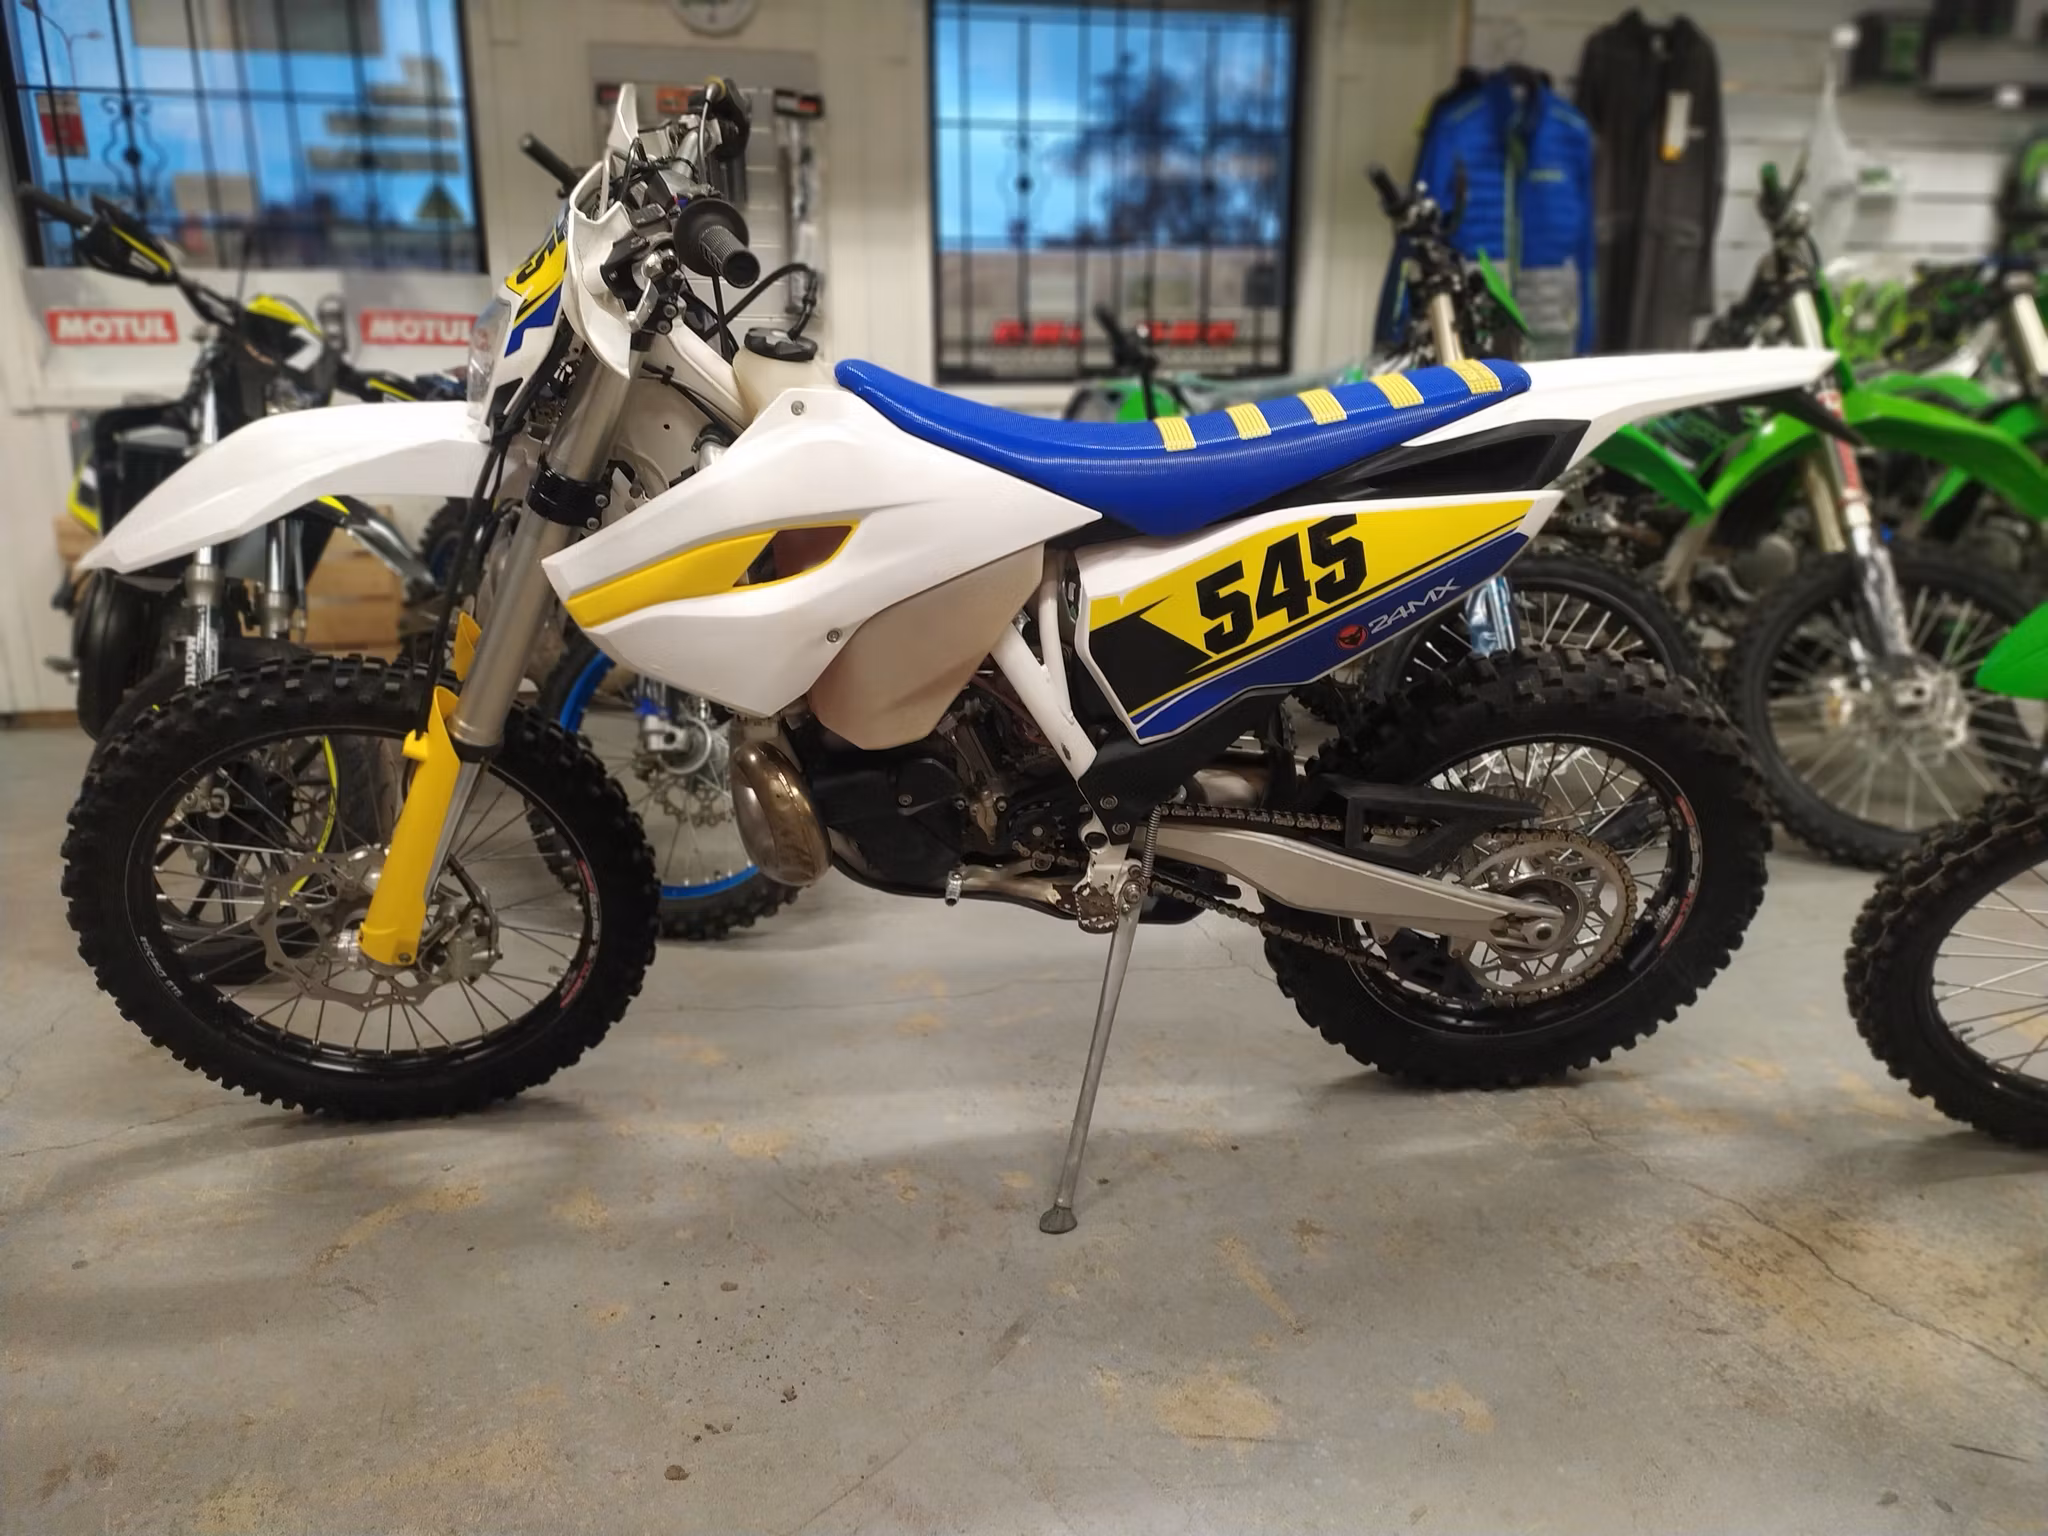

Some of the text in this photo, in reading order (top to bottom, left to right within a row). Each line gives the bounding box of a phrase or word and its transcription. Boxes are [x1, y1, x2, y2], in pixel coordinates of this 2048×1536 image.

[58, 315, 170, 339] MOTUL
[1195, 512, 1368, 655] 545
[1367, 576, 1462, 635] 24MX
[184, 634, 198, 687] MOTU
